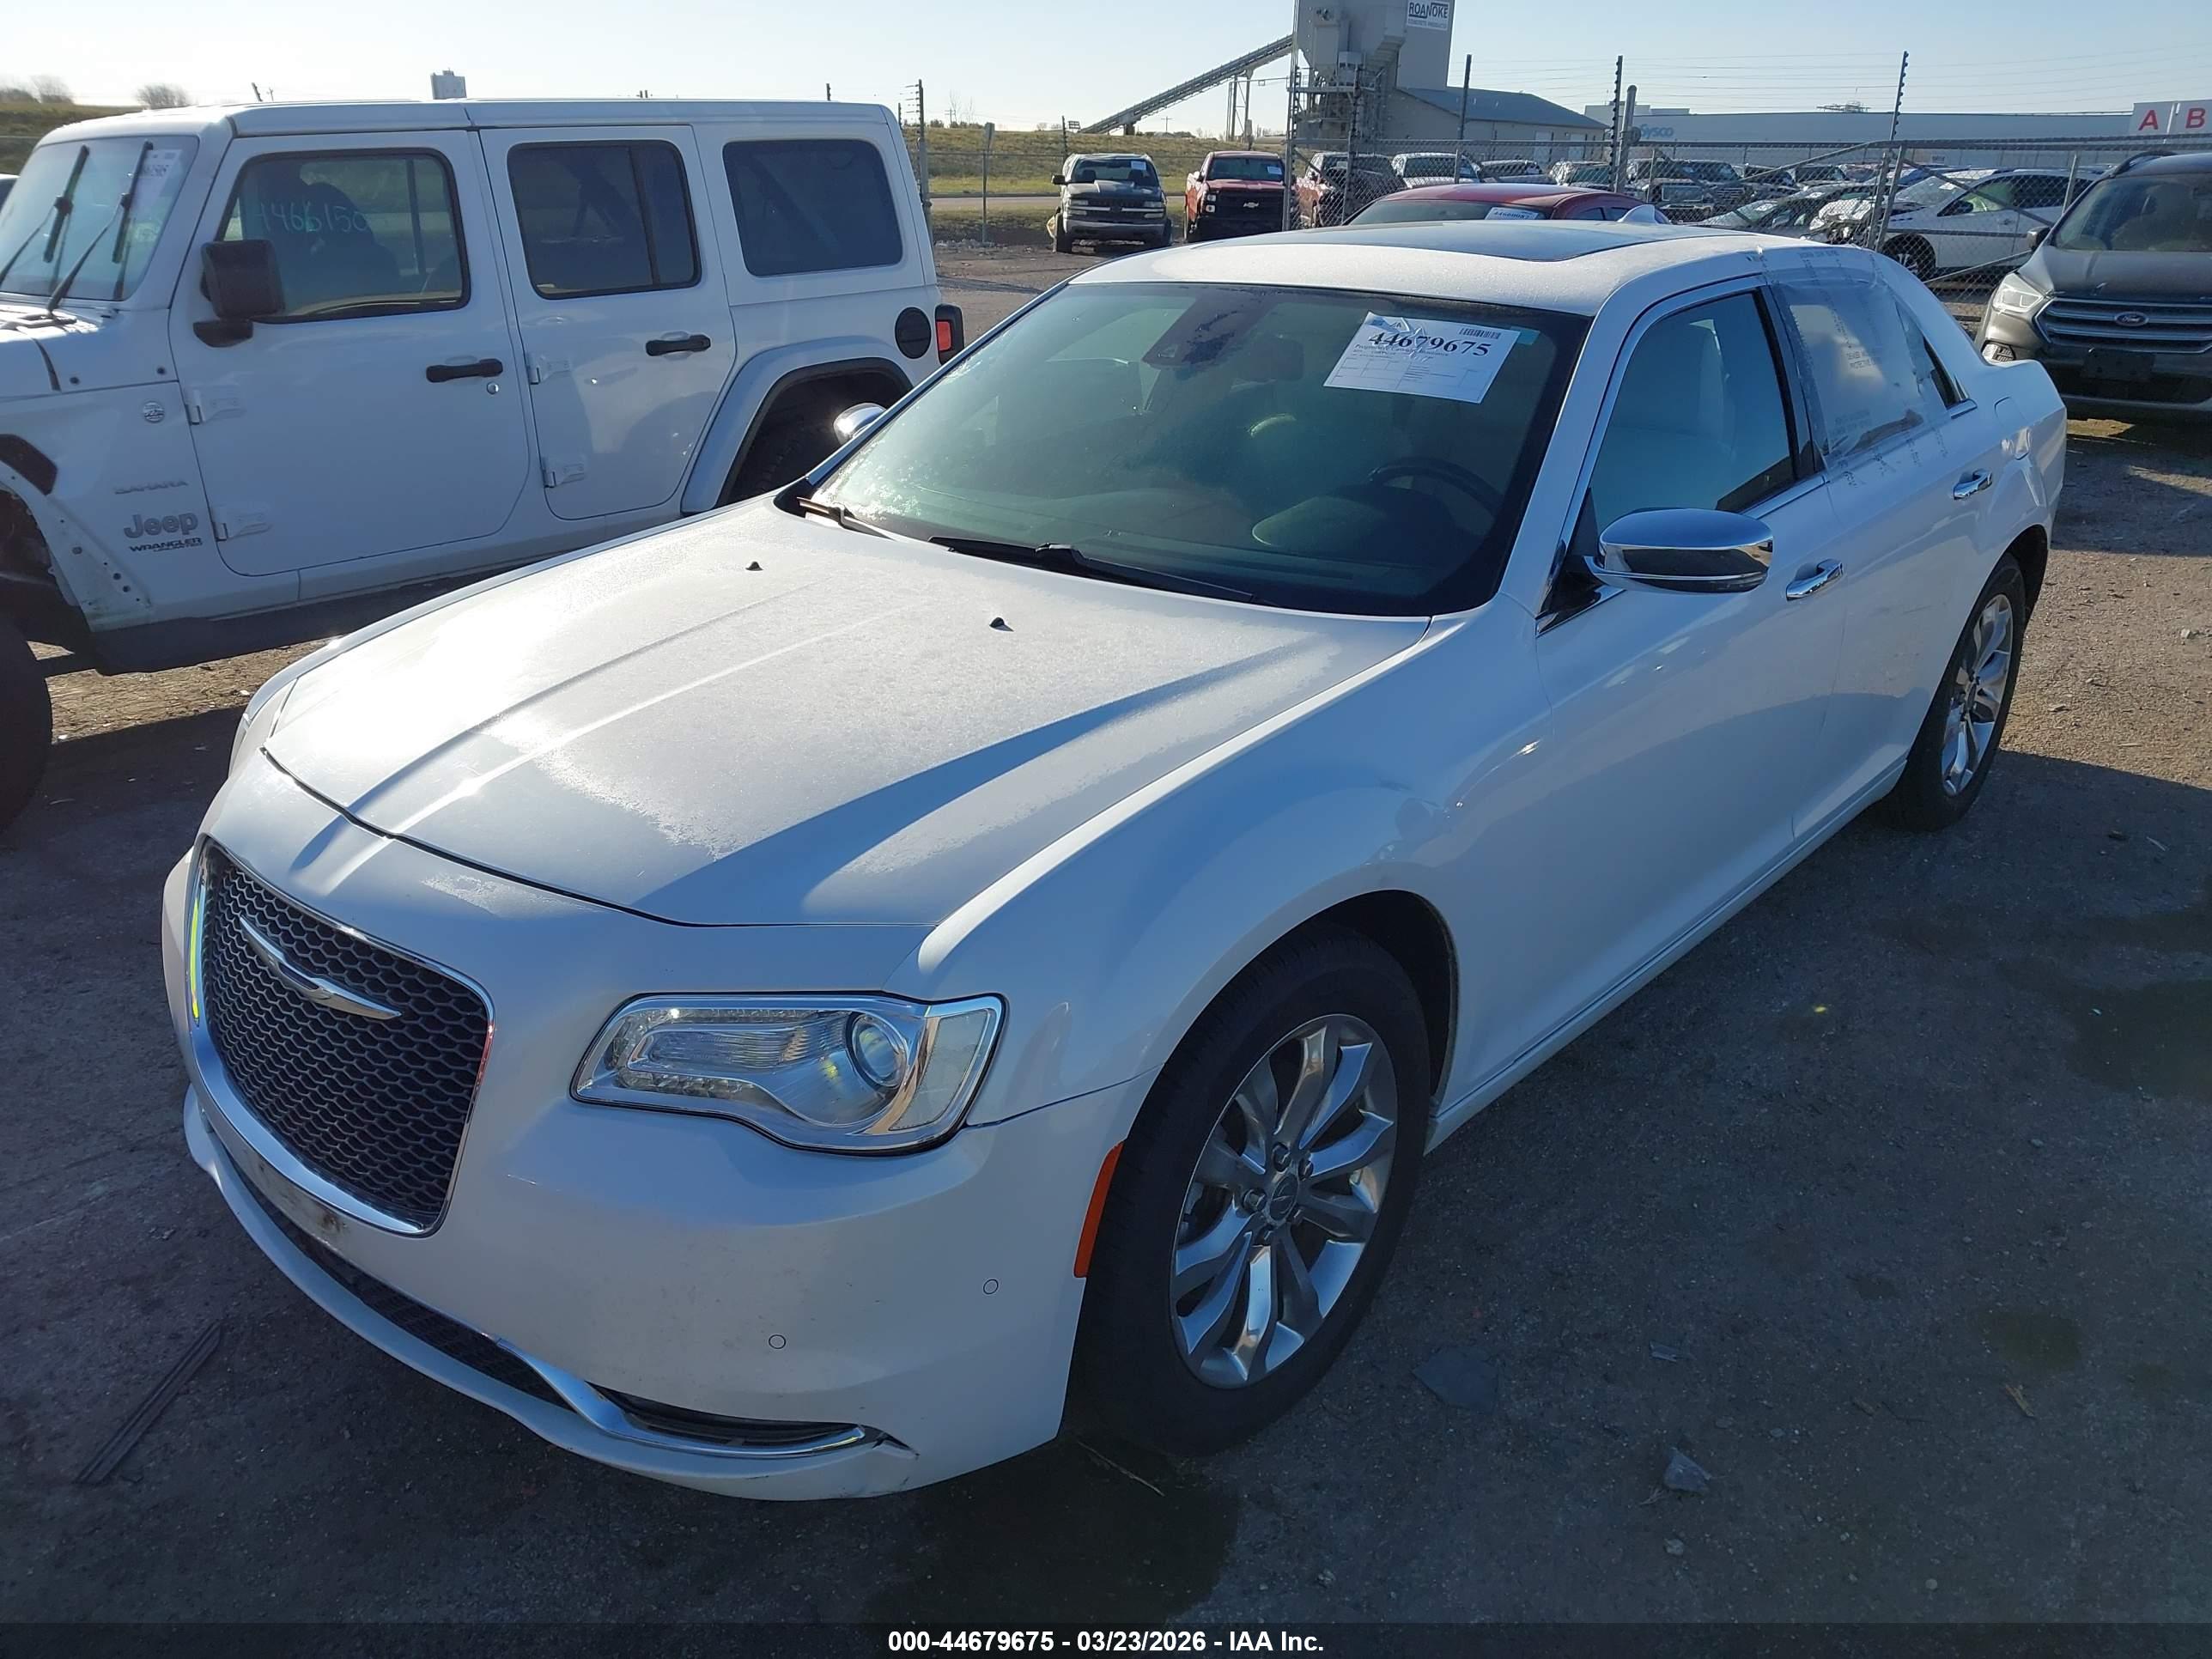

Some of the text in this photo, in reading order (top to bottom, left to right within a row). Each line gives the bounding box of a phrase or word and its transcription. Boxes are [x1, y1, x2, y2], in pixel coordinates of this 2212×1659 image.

[1408, 3, 1449, 19] ROANOKE
[2137, 109, 2159, 131] A
[2185, 106, 2206, 129] B
[1369, 331, 1492, 356] 44679675
[124, 513, 198, 538] Jeep
[129, 537, 202, 552] WRANGLER
